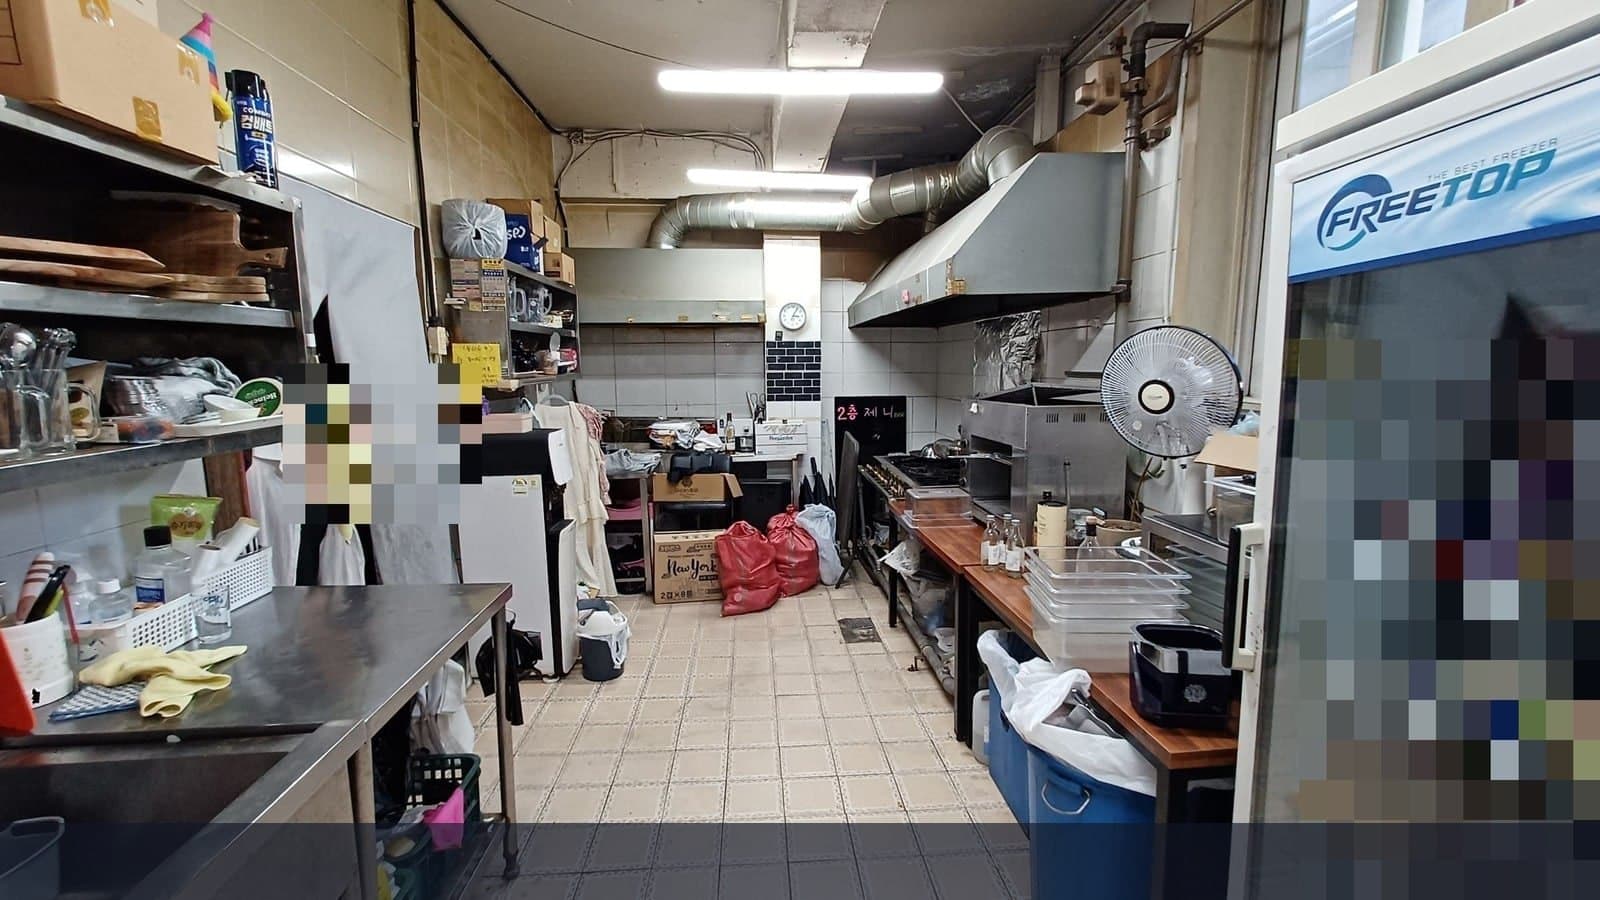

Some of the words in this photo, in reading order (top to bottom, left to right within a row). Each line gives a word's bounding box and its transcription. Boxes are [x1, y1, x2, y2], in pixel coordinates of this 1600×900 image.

[240, 114, 273, 134] 컴배트
[1428, 168, 1449, 182] THE
[1454, 159, 1486, 177] BEST
[1492, 137, 1559, 164] FREEZER
[1325, 148, 1558, 238] FREETOP
[837, 404, 859, 420] 2층
